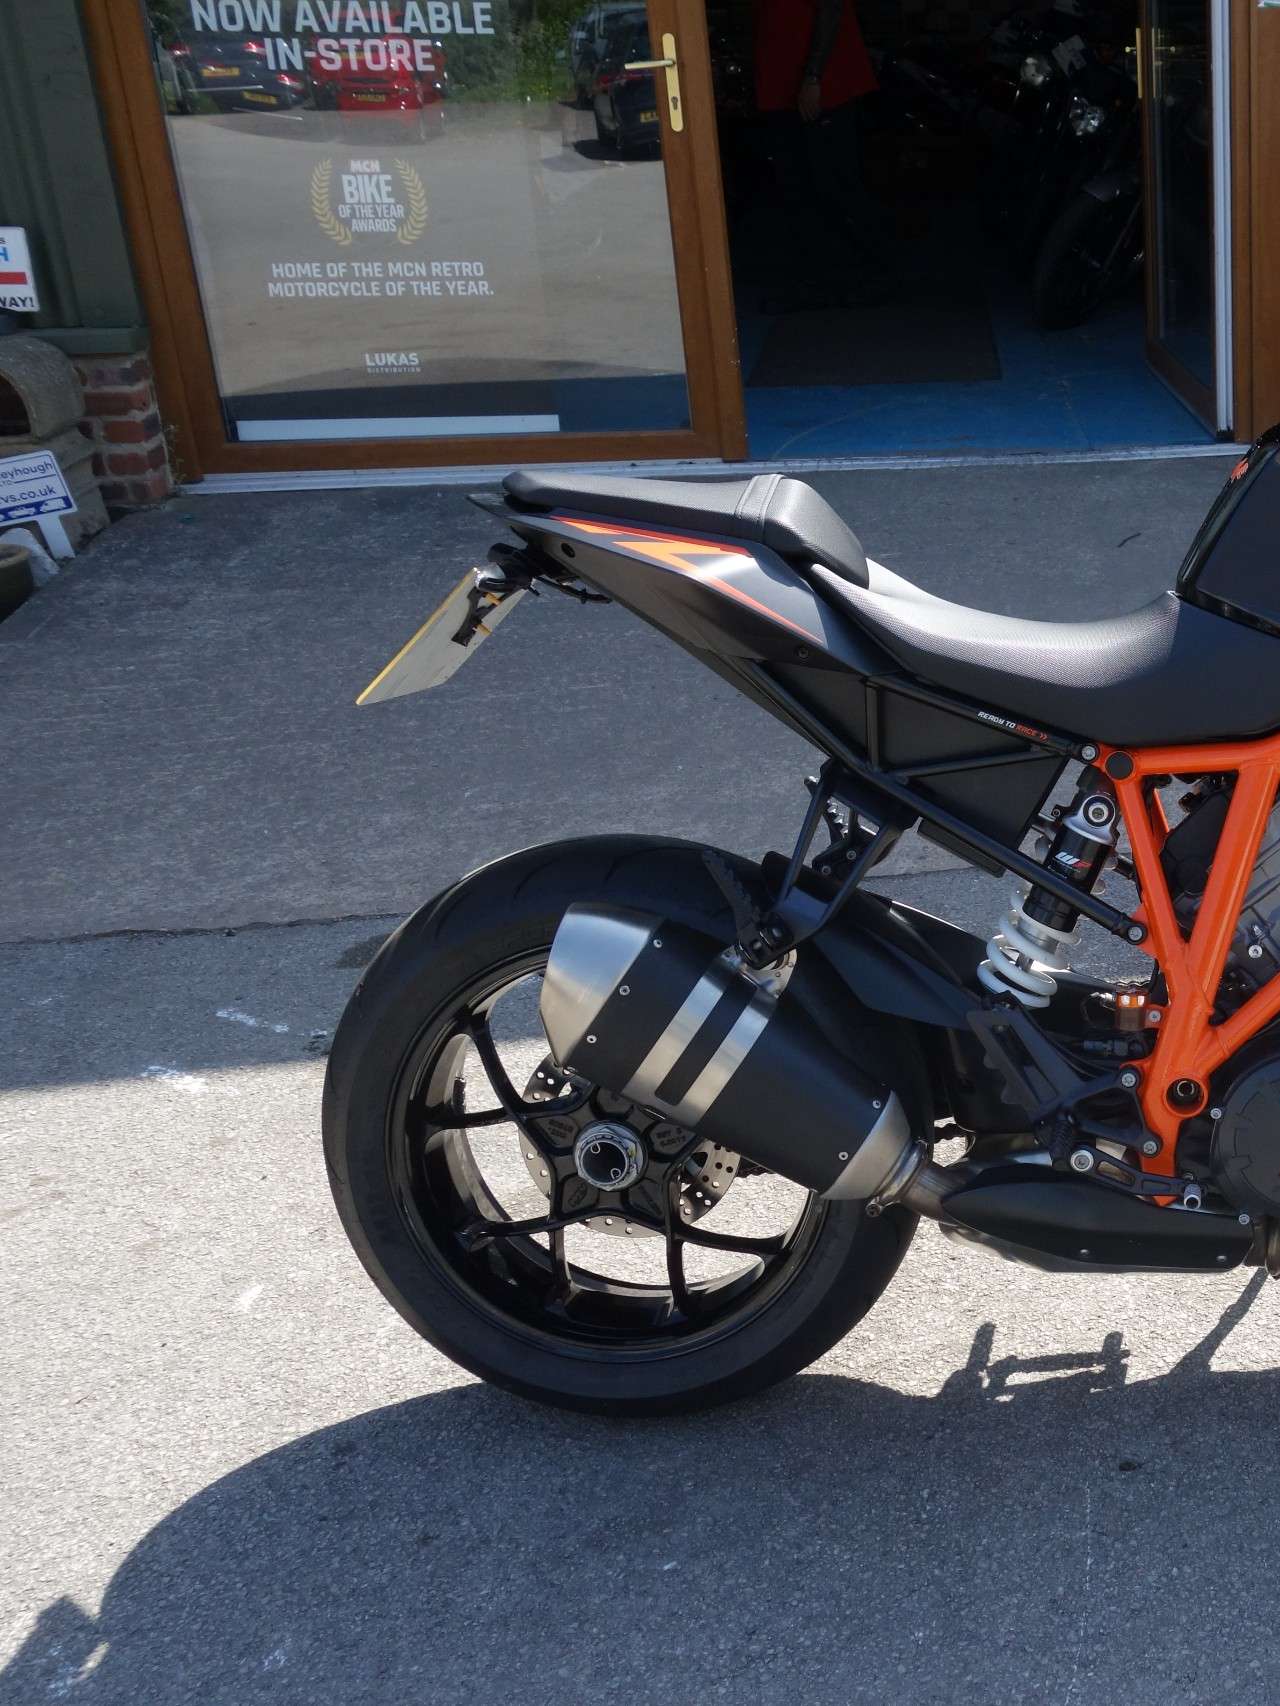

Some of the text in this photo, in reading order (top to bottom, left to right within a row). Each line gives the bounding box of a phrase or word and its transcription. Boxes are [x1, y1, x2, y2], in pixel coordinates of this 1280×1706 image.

[189, 0, 495, 34] NOW AVAILABLE
[263, 38, 436, 72] IN-STORE
[342, 174, 395, 204] BIKE
[338, 204, 405, 218] OF THE YEAR
[351, 219, 398, 232] AWARDS
[272, 262, 485, 278] HOME OF THE MCN RETRO
[268, 280, 495, 297] MOTORCYCLE OF THE YEAR.
[365, 353, 420, 367] LUKAS
[977, 711, 1005, 725] READY
[1005, 720, 1016, 729] TO
